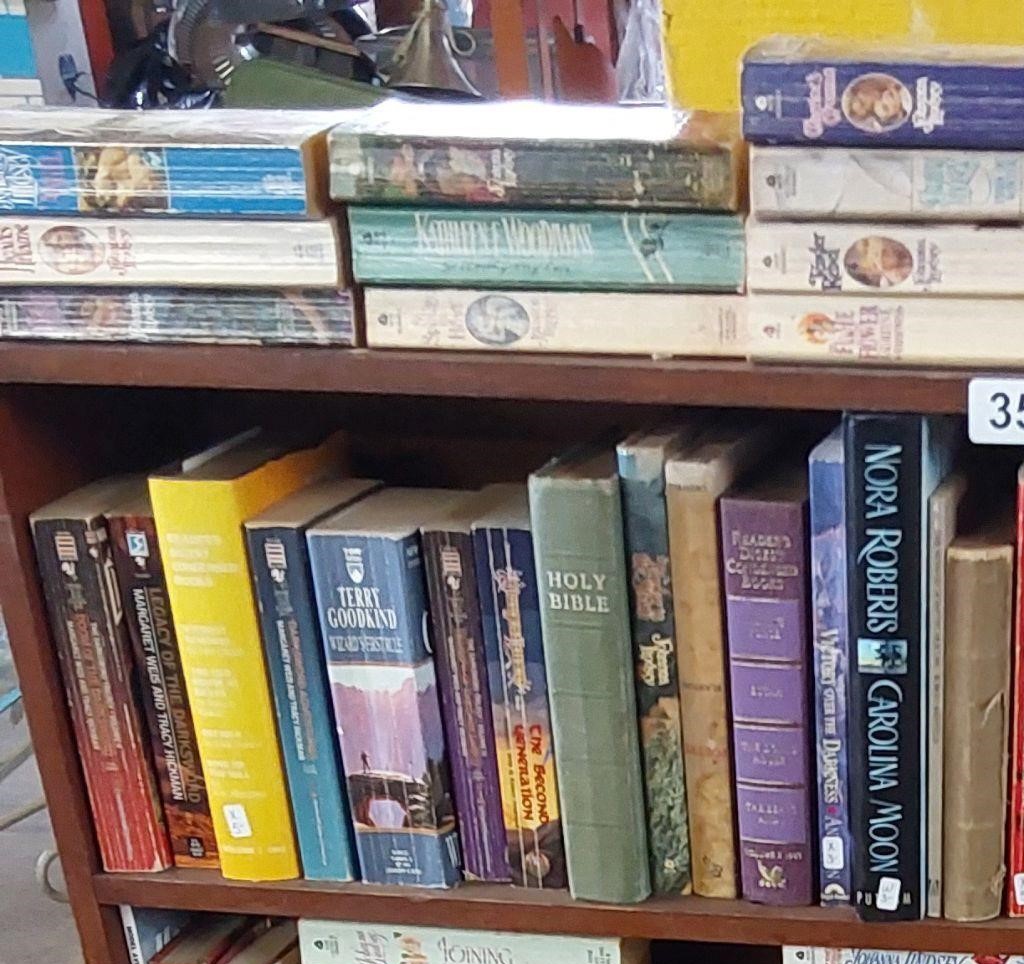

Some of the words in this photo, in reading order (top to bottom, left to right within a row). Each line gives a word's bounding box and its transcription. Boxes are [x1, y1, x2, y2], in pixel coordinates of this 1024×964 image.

[863, 444, 903, 519] NORA
[337, 587, 380, 609] TERRY
[546, 571, 608, 591] HOLY
[549, 593, 610, 613] BIBLE
[857, 528, 904, 633] ROBERTS
[328, 607, 397, 630] GOODKIND
[865, 679, 902, 792] CAROLINA
[868, 798, 900, 874] MOON
